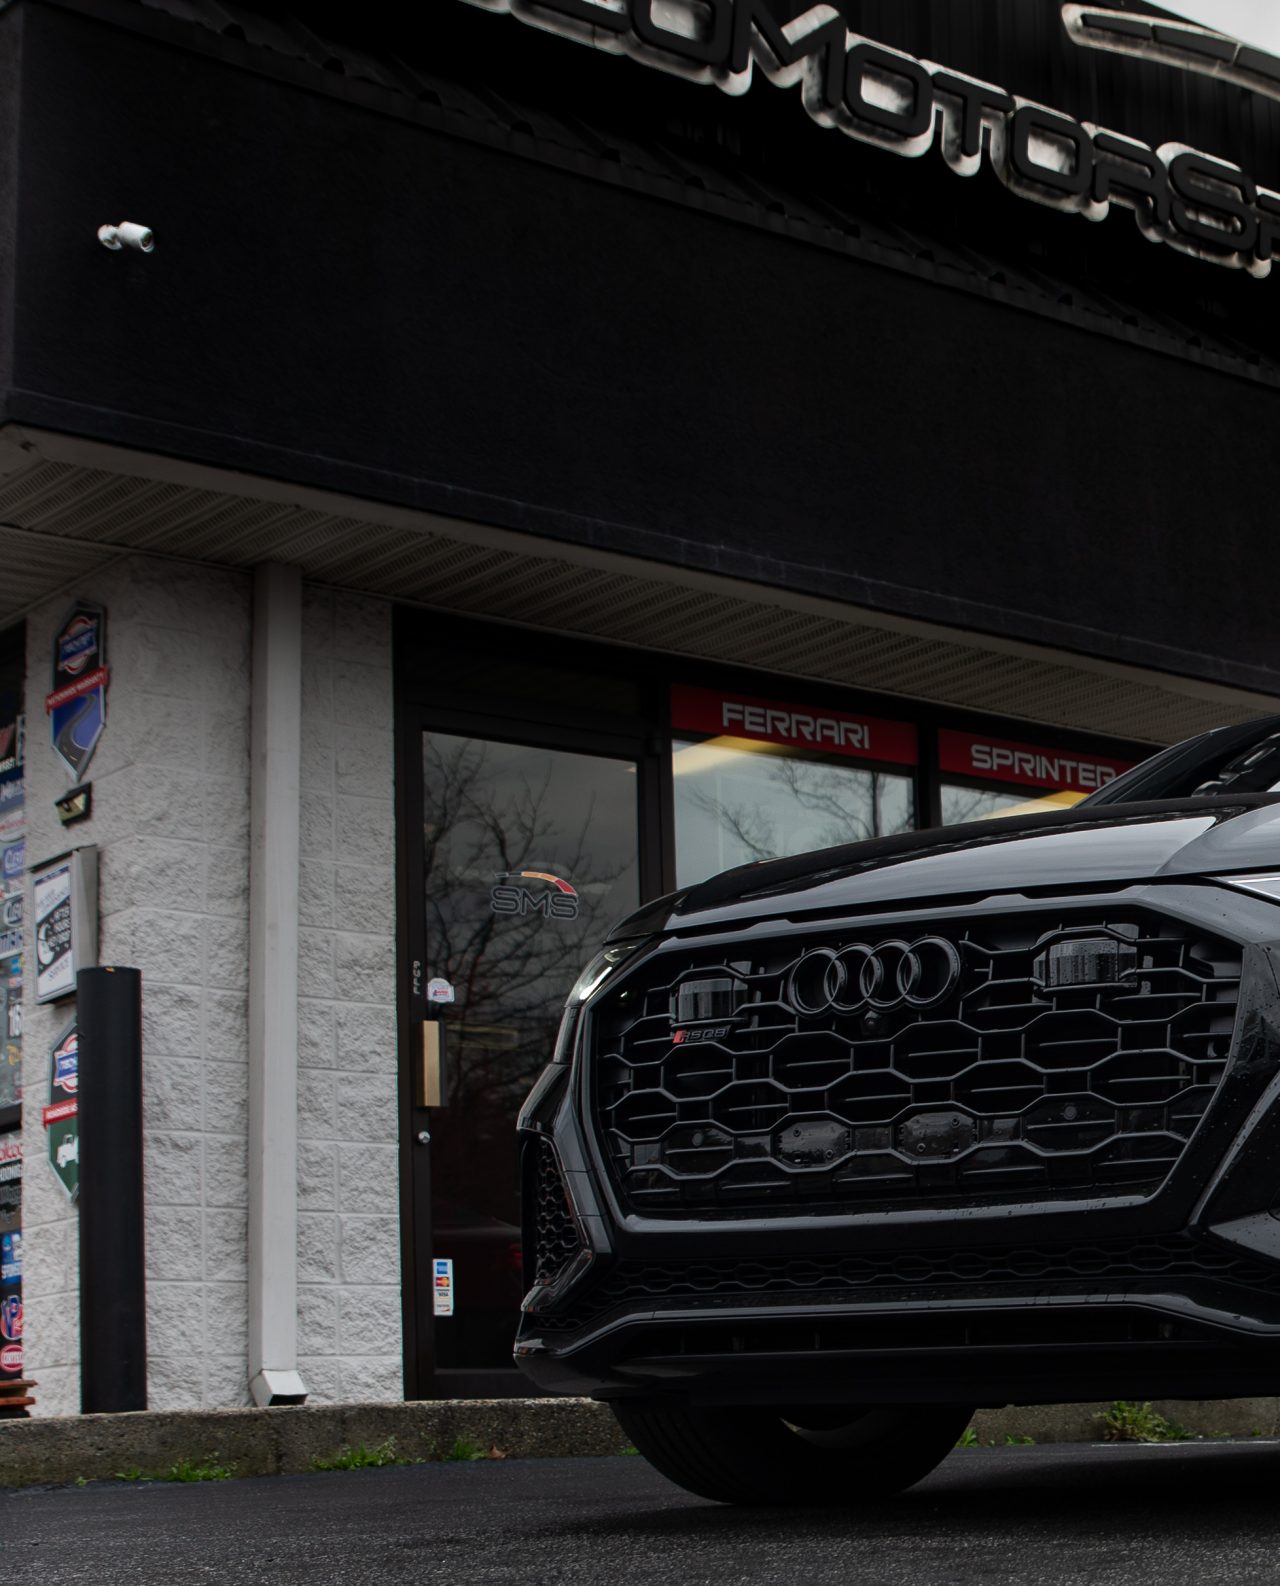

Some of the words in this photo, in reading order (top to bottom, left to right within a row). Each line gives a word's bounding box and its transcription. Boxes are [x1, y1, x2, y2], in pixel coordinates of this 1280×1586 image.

[722, 702, 870, 750] FERRARI
[971, 744, 1116, 787] SPRINTER
[490, 885, 579, 921] SMS
[413, 960, 421, 994] PULL
